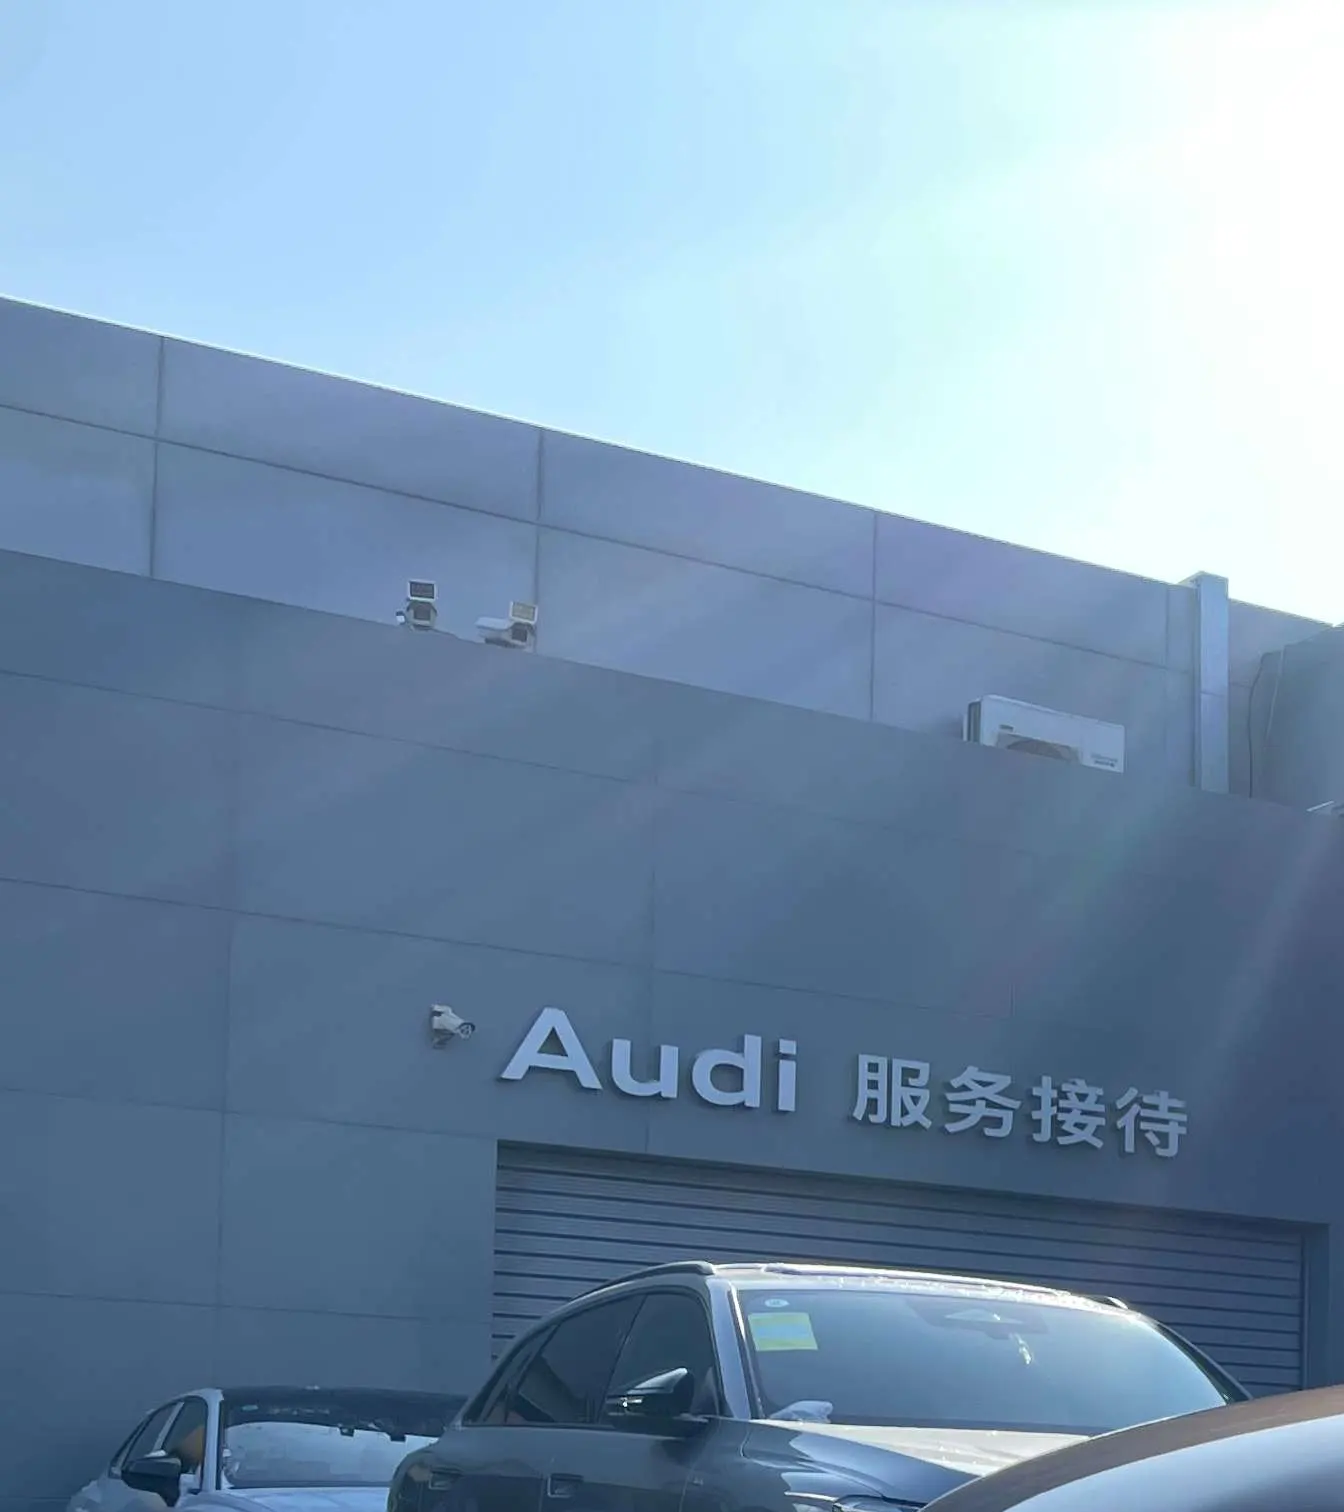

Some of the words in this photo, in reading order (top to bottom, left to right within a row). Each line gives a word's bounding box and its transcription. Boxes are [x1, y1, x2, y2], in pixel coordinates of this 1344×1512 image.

[500, 1007, 797, 1113] Audi
[852, 1053, 1189, 1159] 服务接待
